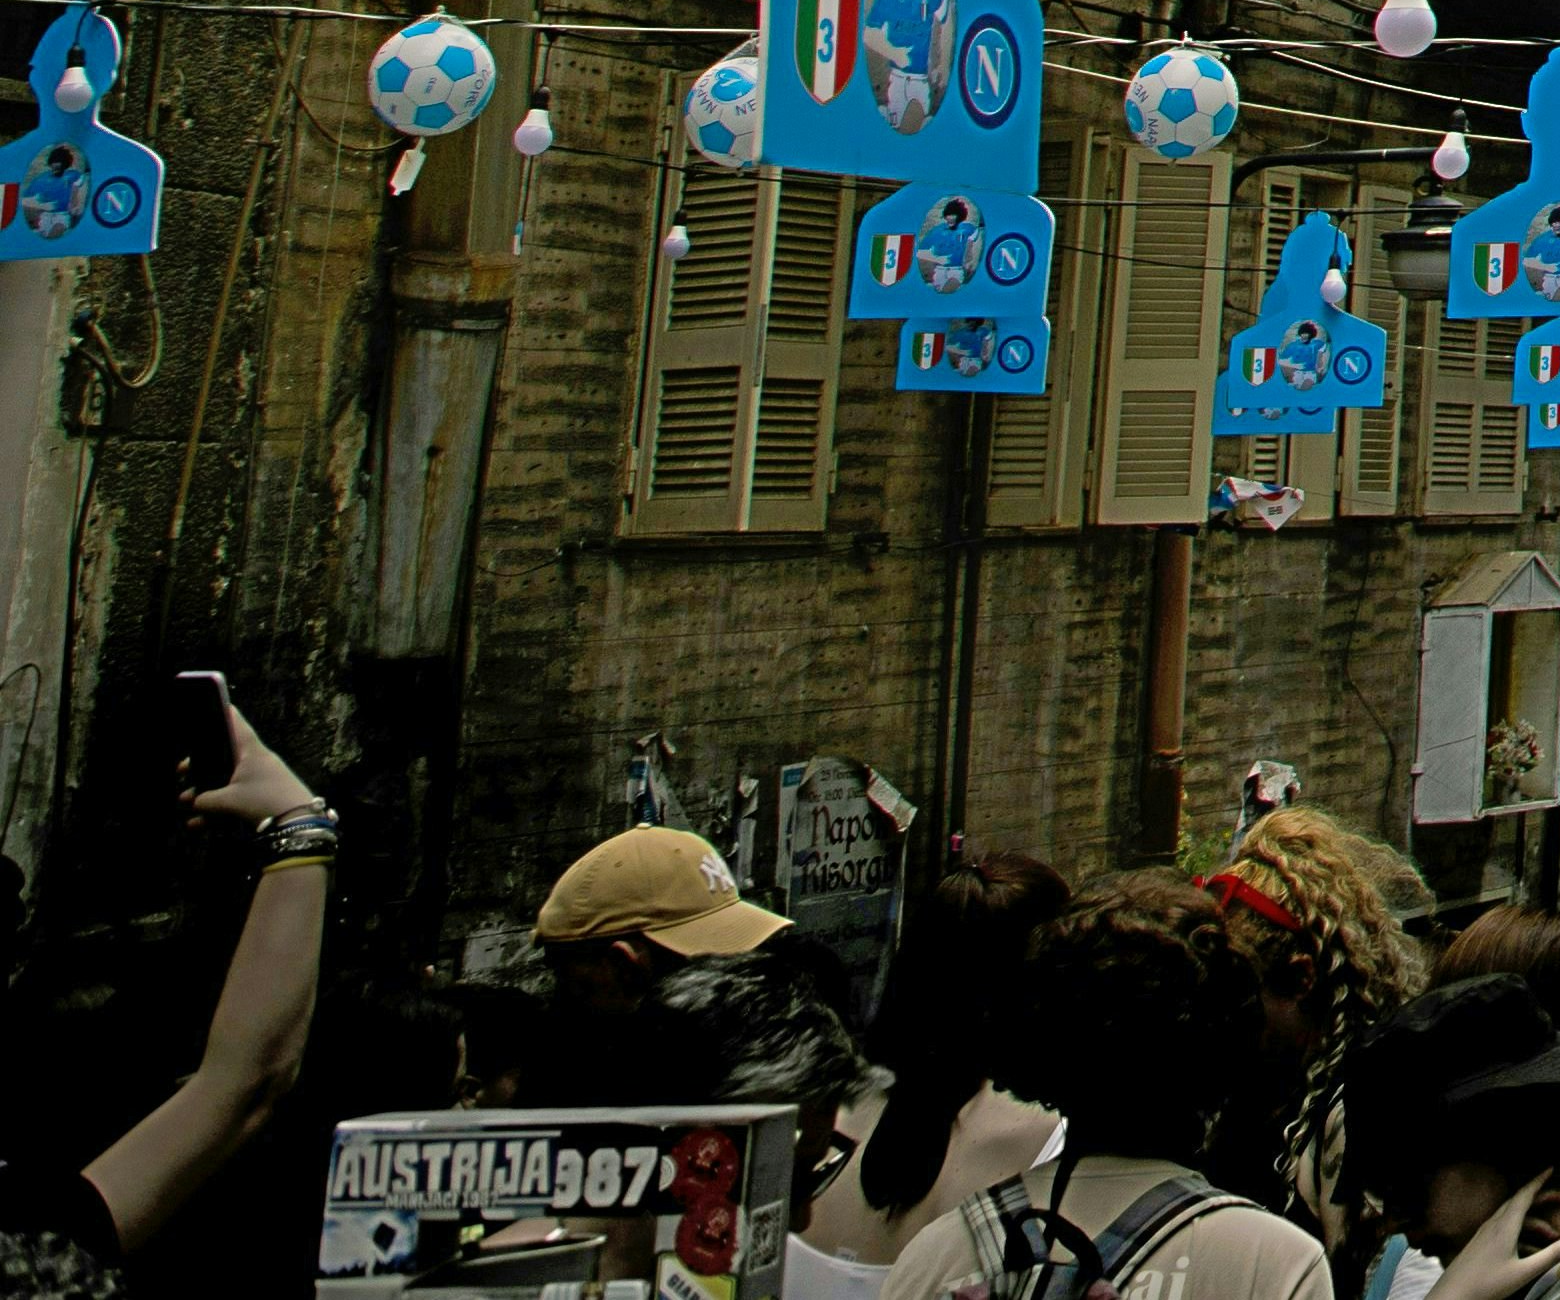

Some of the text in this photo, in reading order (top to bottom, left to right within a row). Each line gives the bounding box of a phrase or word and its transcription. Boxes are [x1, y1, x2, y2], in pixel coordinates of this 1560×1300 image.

[818, 18, 835, 64] 3
[973, 44, 1007, 98] N
[885, 249, 897, 271] 3
[998, 247, 1022, 272] N
[1490, 256, 1501, 278] 3
[332, 1138, 554, 1199] AUSTRIJA
